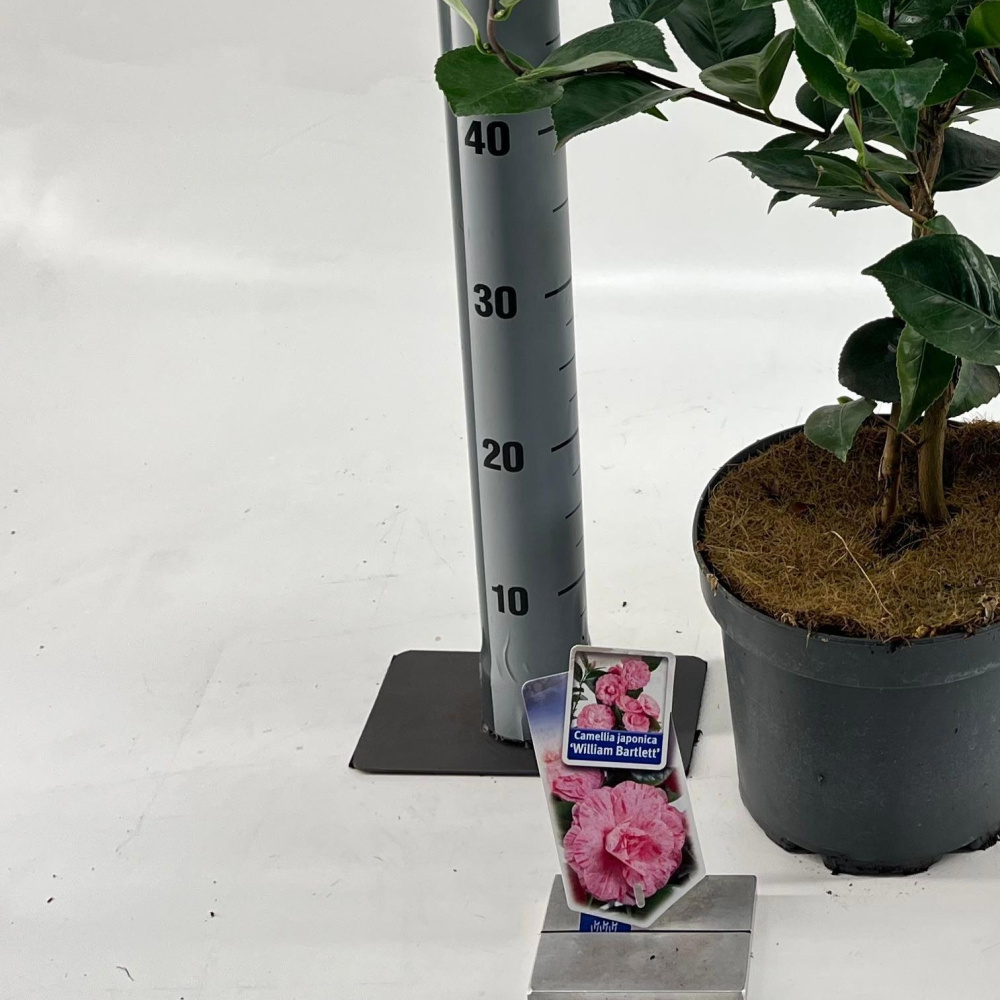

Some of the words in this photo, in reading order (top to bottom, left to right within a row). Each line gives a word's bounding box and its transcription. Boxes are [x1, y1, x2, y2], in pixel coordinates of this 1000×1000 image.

[464, 120, 511, 157] 40
[473, 283, 518, 320] 30
[482, 438, 525, 473] 20
[491, 584, 530, 617] 10
[573, 730, 615, 742] Camellia
[616, 733, 658, 745] japonica
